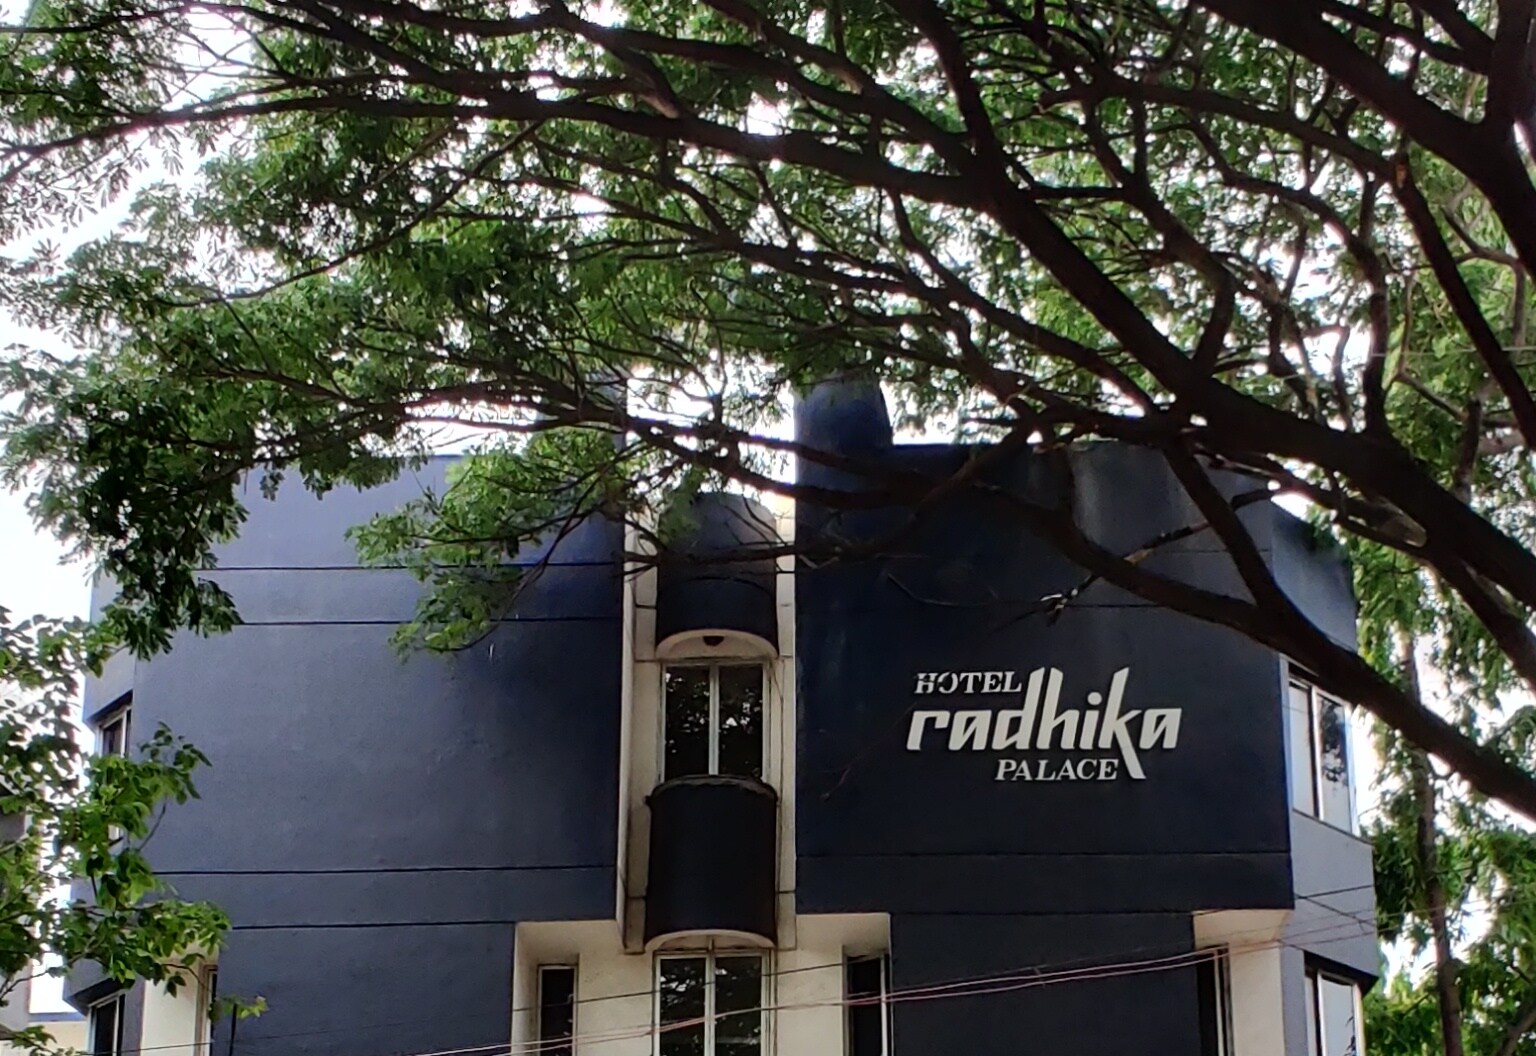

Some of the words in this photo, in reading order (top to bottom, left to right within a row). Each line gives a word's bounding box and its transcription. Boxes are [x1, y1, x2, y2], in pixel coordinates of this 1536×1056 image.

[914, 670, 1022, 694] HOTEL
[906, 666, 1182, 780] radhika
[994, 758, 1119, 781] PALACE
